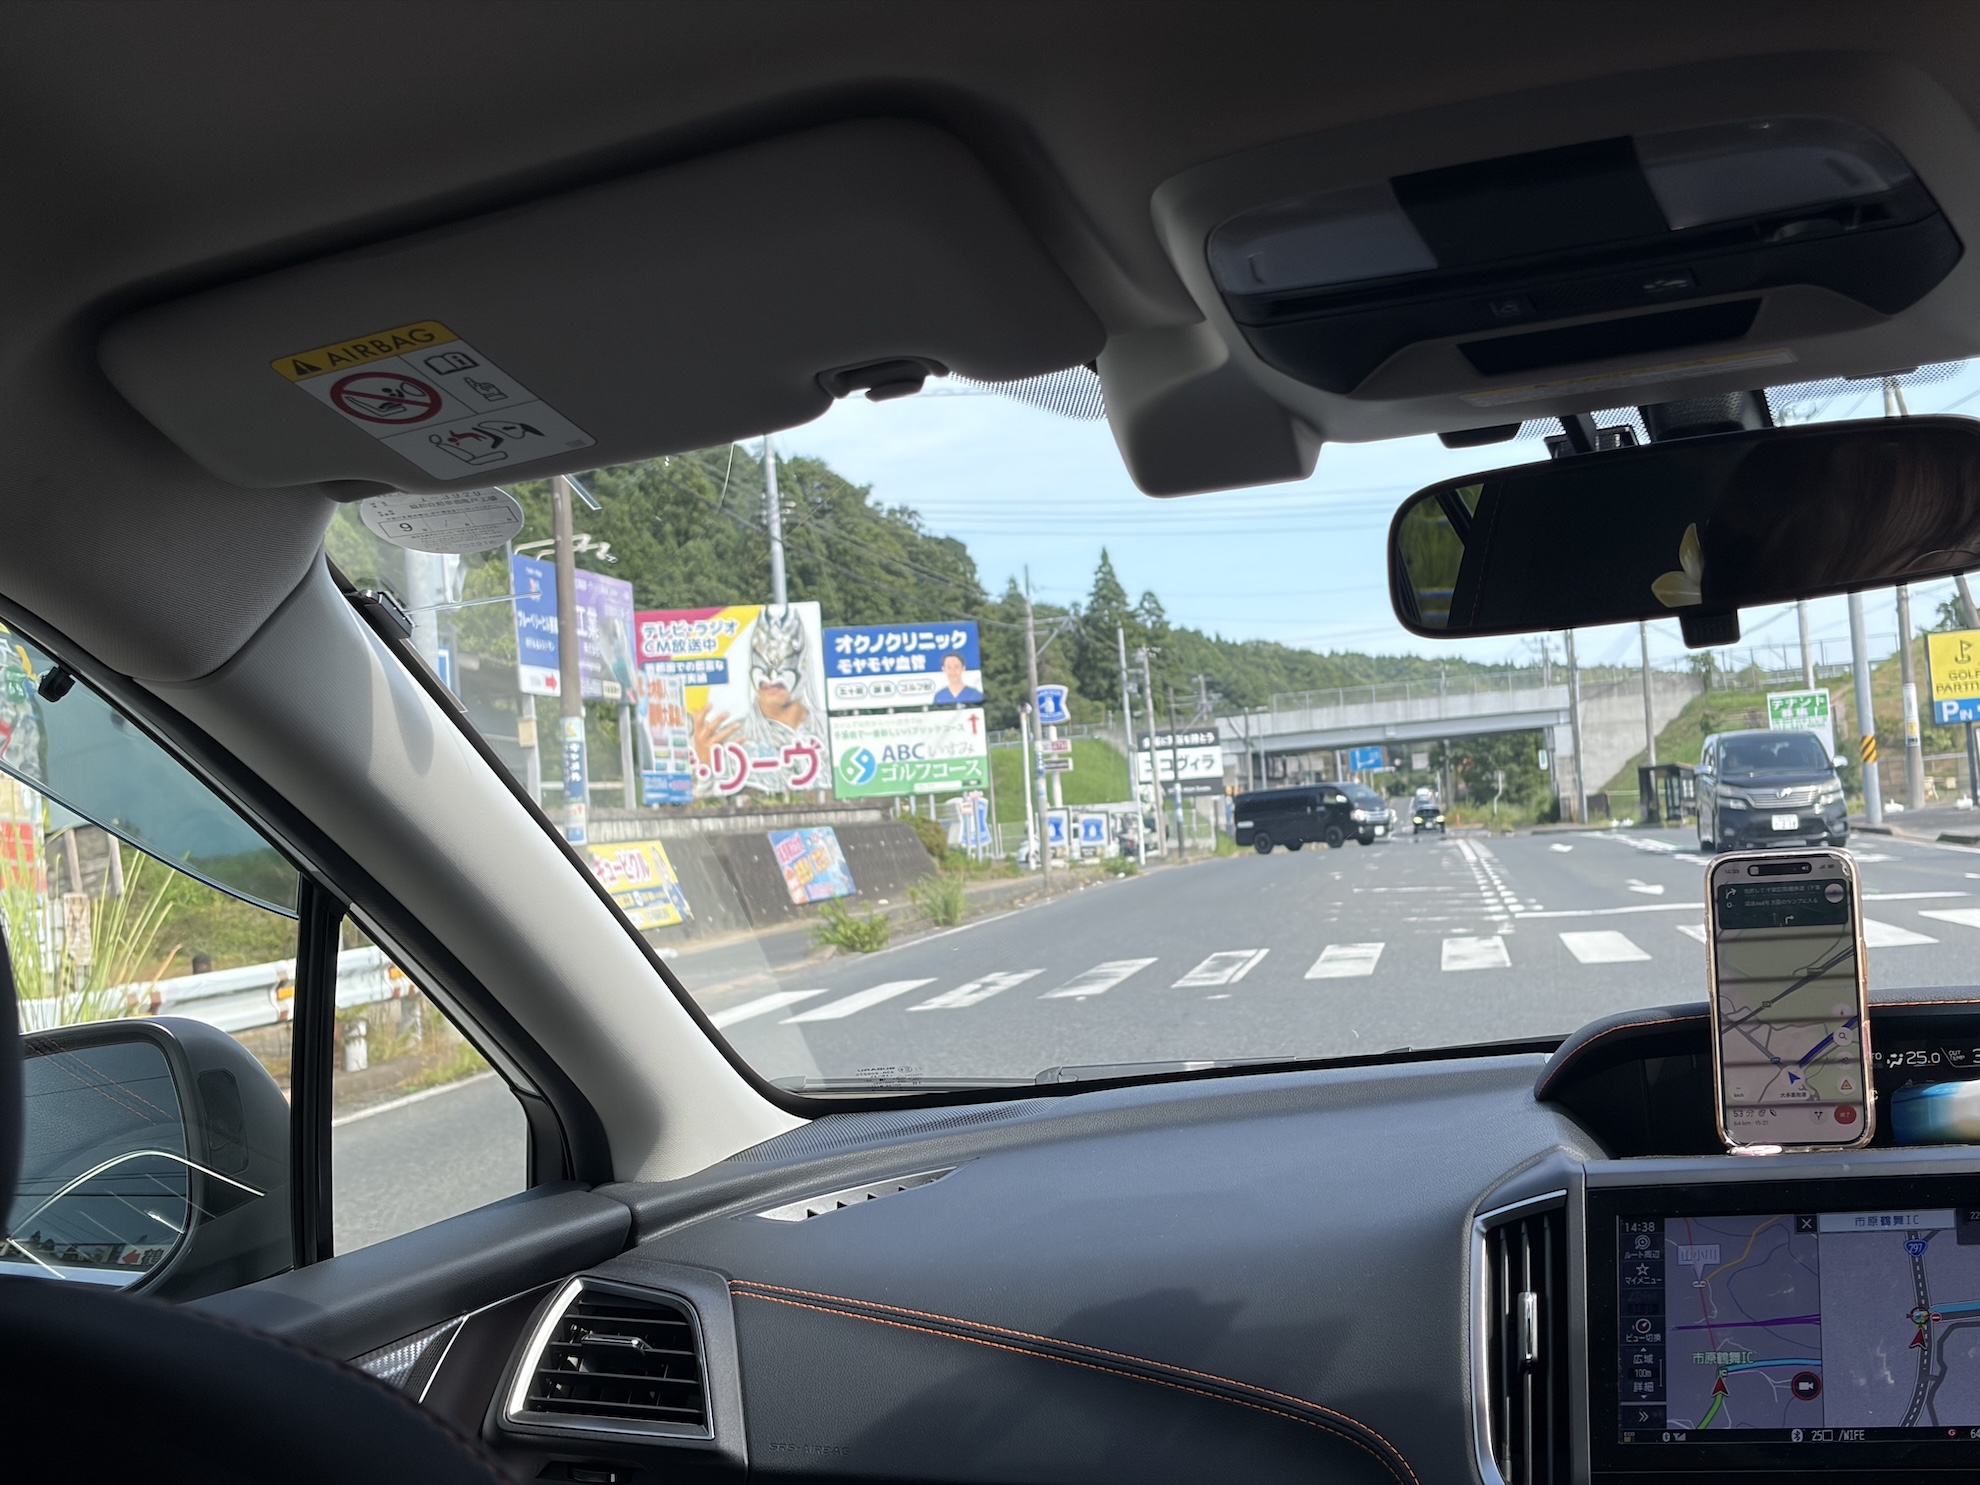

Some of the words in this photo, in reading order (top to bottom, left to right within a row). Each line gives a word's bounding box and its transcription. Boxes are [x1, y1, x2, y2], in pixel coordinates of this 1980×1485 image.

[326, 328, 437, 368] AIRBAG
[644, 620, 738, 639] テレビ・ラジオ
[644, 638, 717, 654] CM放送中
[834, 630, 968, 654] オクノクリニック
[836, 655, 927, 673] モヤモヤ血管
[1949, 668, 1980, 681] GOLF
[1772, 696, 1825, 711] テナント
[1942, 700, 1960, 723] P
[881, 759, 983, 783] ゴルフコース
[1906, 1051, 1941, 1065] 25.0
[1733, 1110, 1744, 1118] 53
[1855, 1215, 1920, 1227] 市原鶴舞IC
[1624, 1222, 1656, 1233] 14:38
[1624, 1250, 1661, 1259] ルート周辺
[1625, 1276, 1662, 1285] マイメニュー
[1625, 1333, 1661, 1343] ビュー切換
[1633, 1354, 1654, 1364] 広域
[1692, 1352, 1754, 1364] 市原鶴舞IC
[1635, 1368, 1652, 1378] 100m
[1633, 1382, 1654, 1392] 詳細
